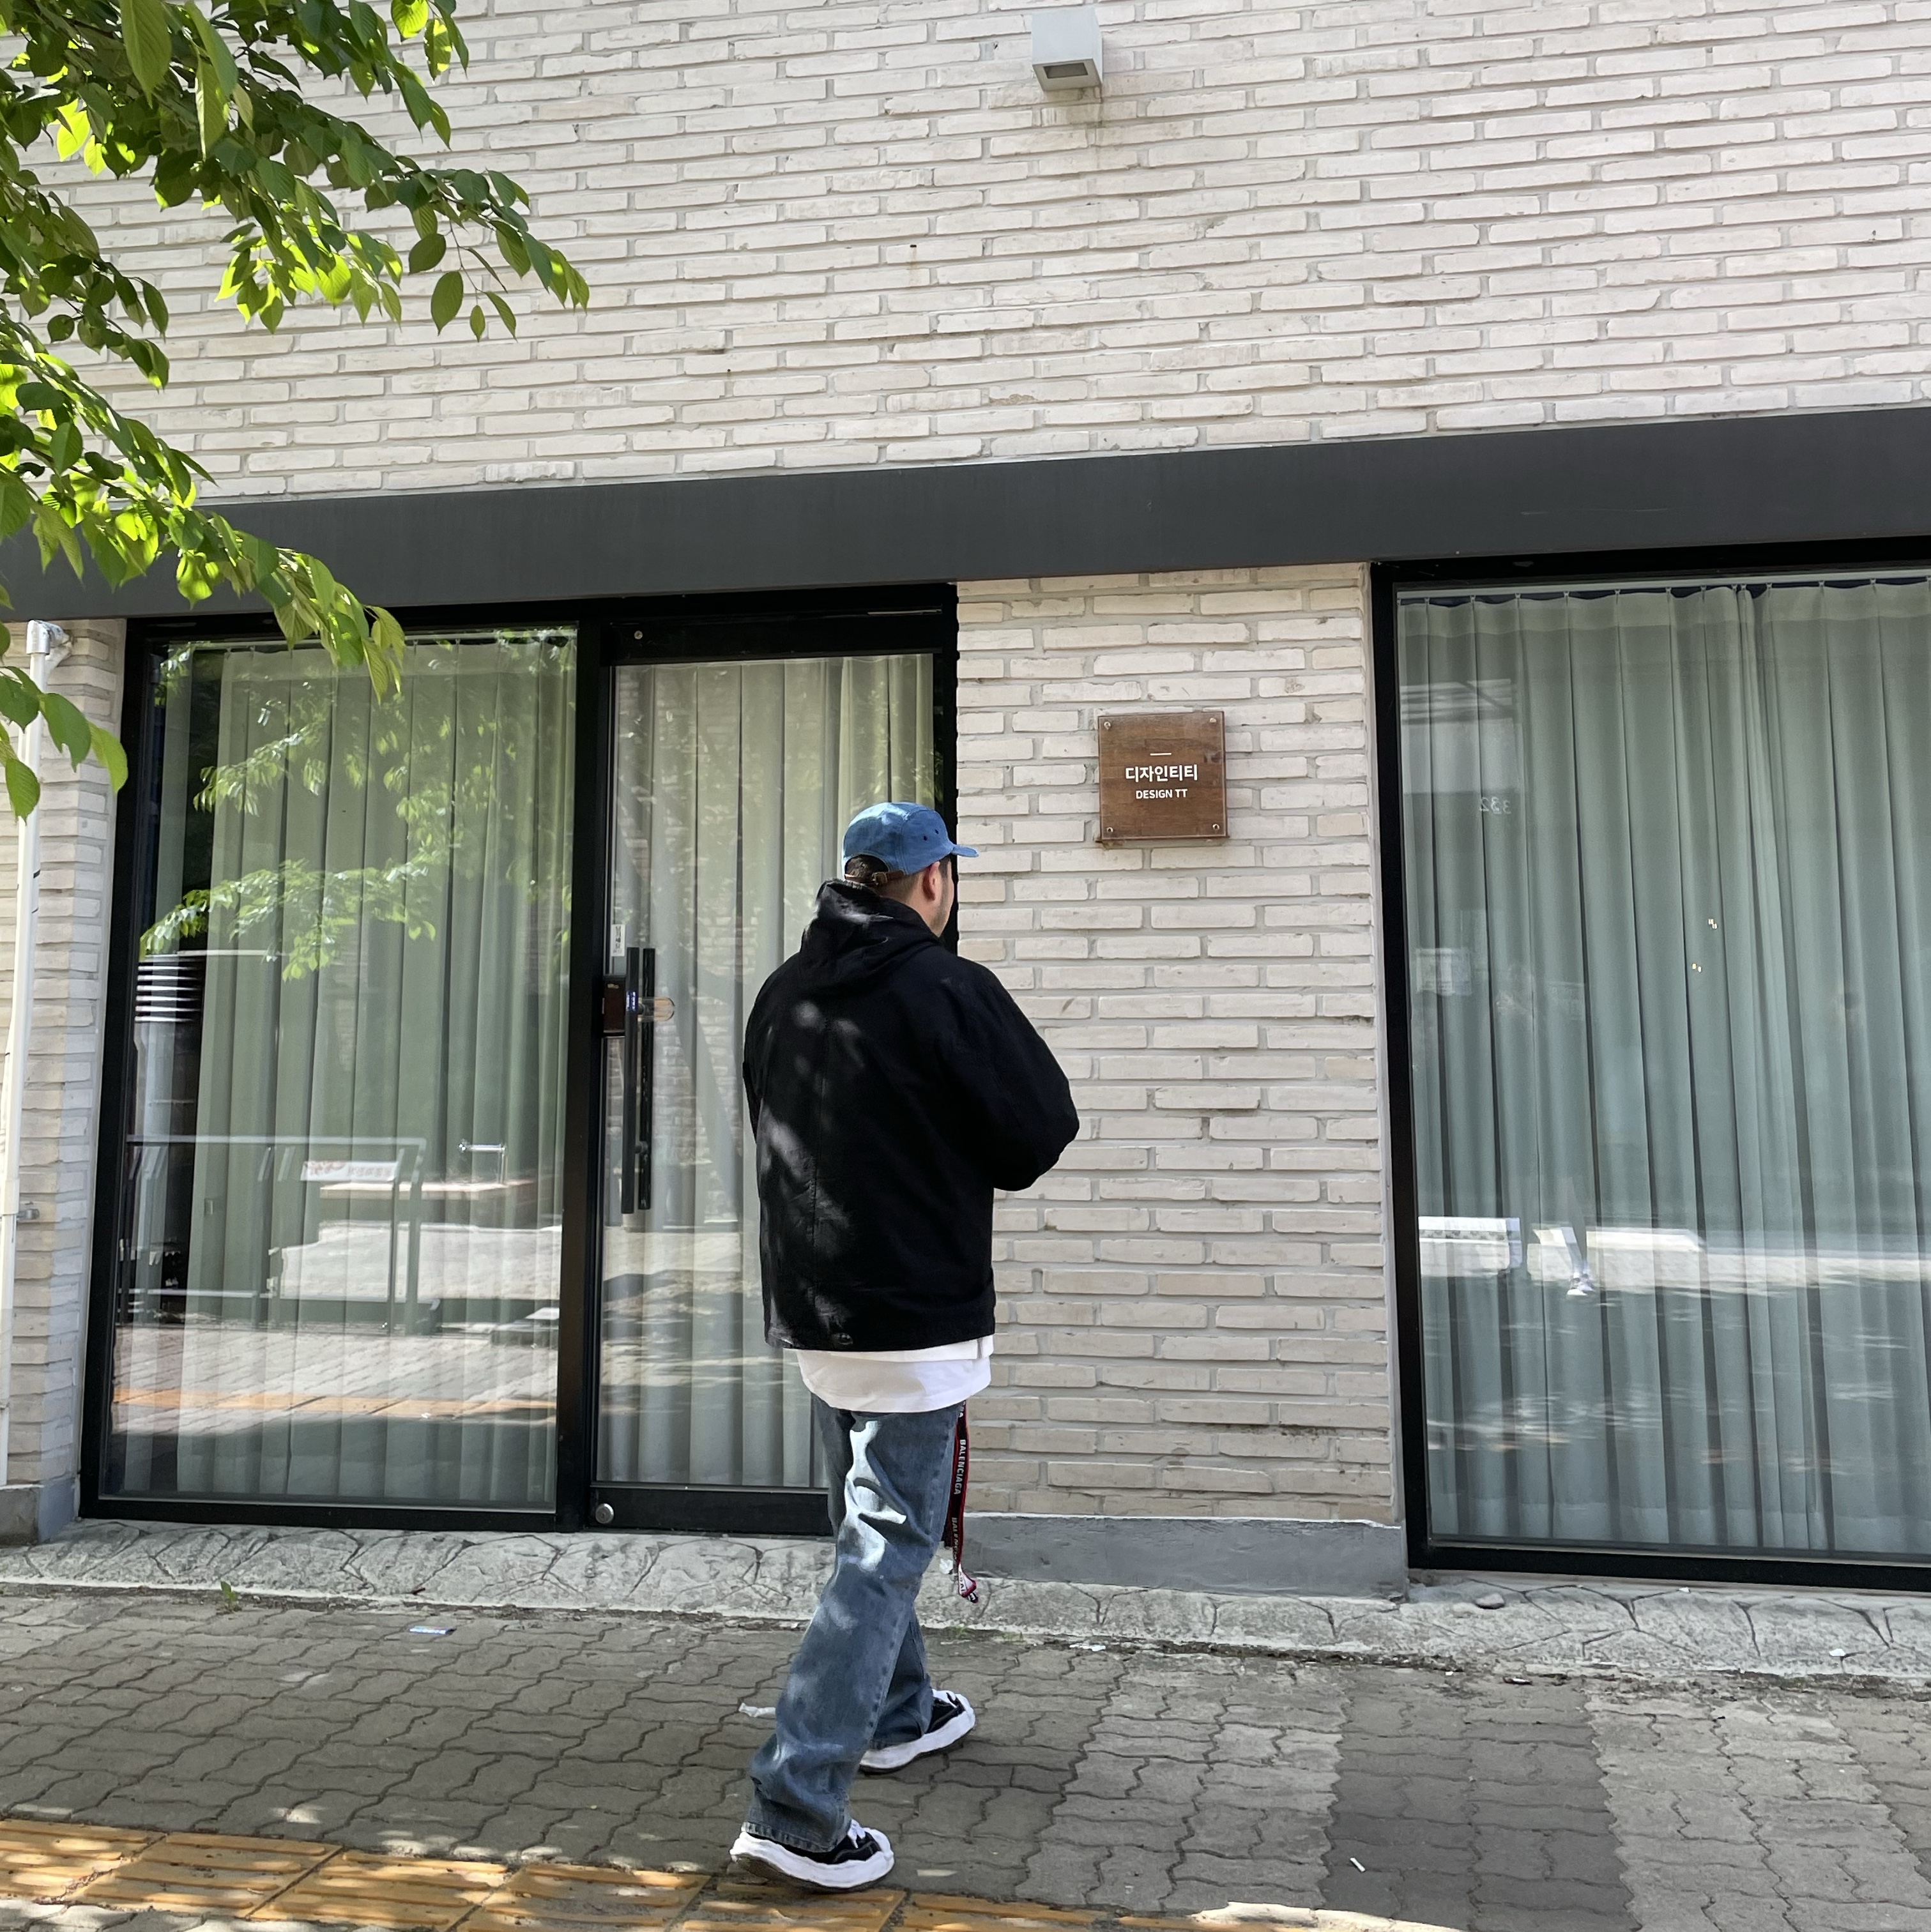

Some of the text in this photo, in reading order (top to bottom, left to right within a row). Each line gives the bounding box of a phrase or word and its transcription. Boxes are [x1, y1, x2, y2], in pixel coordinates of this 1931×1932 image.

[1125, 764, 1198, 782] 디자인티티
[1136, 789, 1188, 800] DESIGN TT
[954, 1439, 966, 1495] BALENCIAGA
